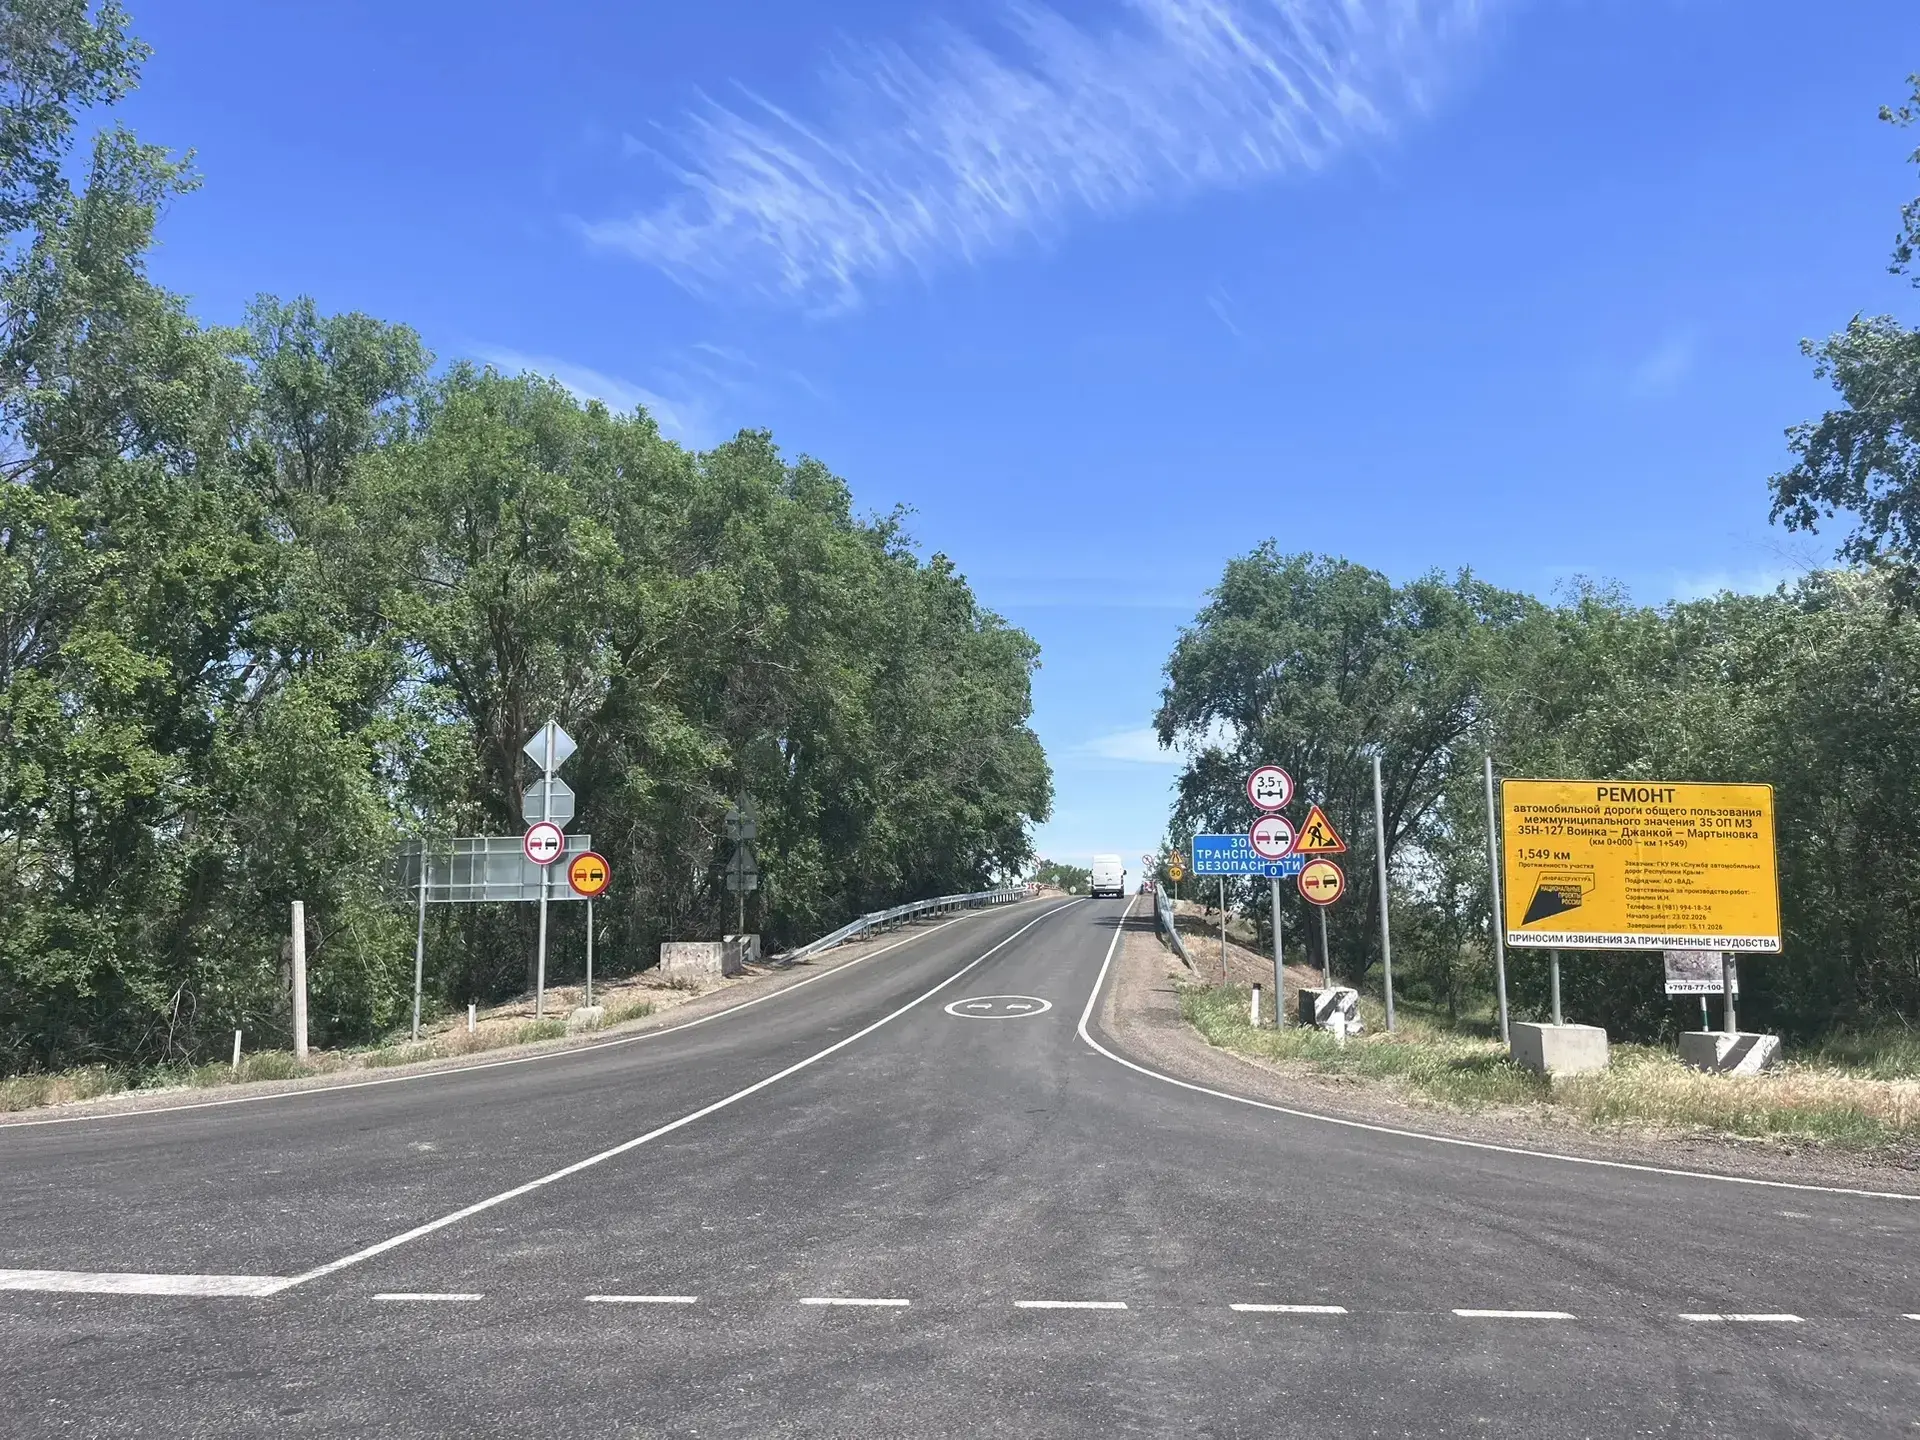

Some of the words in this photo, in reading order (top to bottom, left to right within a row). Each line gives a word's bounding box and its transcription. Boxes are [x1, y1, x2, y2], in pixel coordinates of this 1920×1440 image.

[1257, 777, 1275, 788] 3,5
[1597, 787, 1675, 803] РЕМОНТ
[1513, 804, 1600, 814] автомобильной
[1604, 806, 1642, 816] дороги
[1645, 806, 1686, 817] общего
[1690, 808, 1762, 817] пользования
[1524, 816, 1640, 827] межмуниципального
[1644, 819, 1695, 827] значения
[1699, 818, 1712, 827] 35
[1716, 818, 1731, 828] ОП
[1735, 819, 1752, 829] МЗ
[1518, 825, 1563, 835] 35Н-127
[1567, 827, 1607, 837] Воинка
[1621, 828, 1673, 838] Джанкой
[1687, 829, 1758, 840] Мартыновка
[1589, 838, 1604, 846] (км
[1659, 840, 1688, 849] 1+549)
[1518, 849, 1550, 861] 1,549
[1554, 852, 1570, 860] км
[1197, 861, 1300, 870] БЕЗОПАСНТИ
[1509, 934, 1563, 943] ПРИНОСИМ
[1566, 935, 1622, 944] ИЗВИНЕНИЯ
[1624, 936, 1637, 944] ЗА
[1638, 936, 1712, 946] ПРИЧИНЕННЫЕ
[1714, 938, 1777, 948] НЕУДОБСТВА
